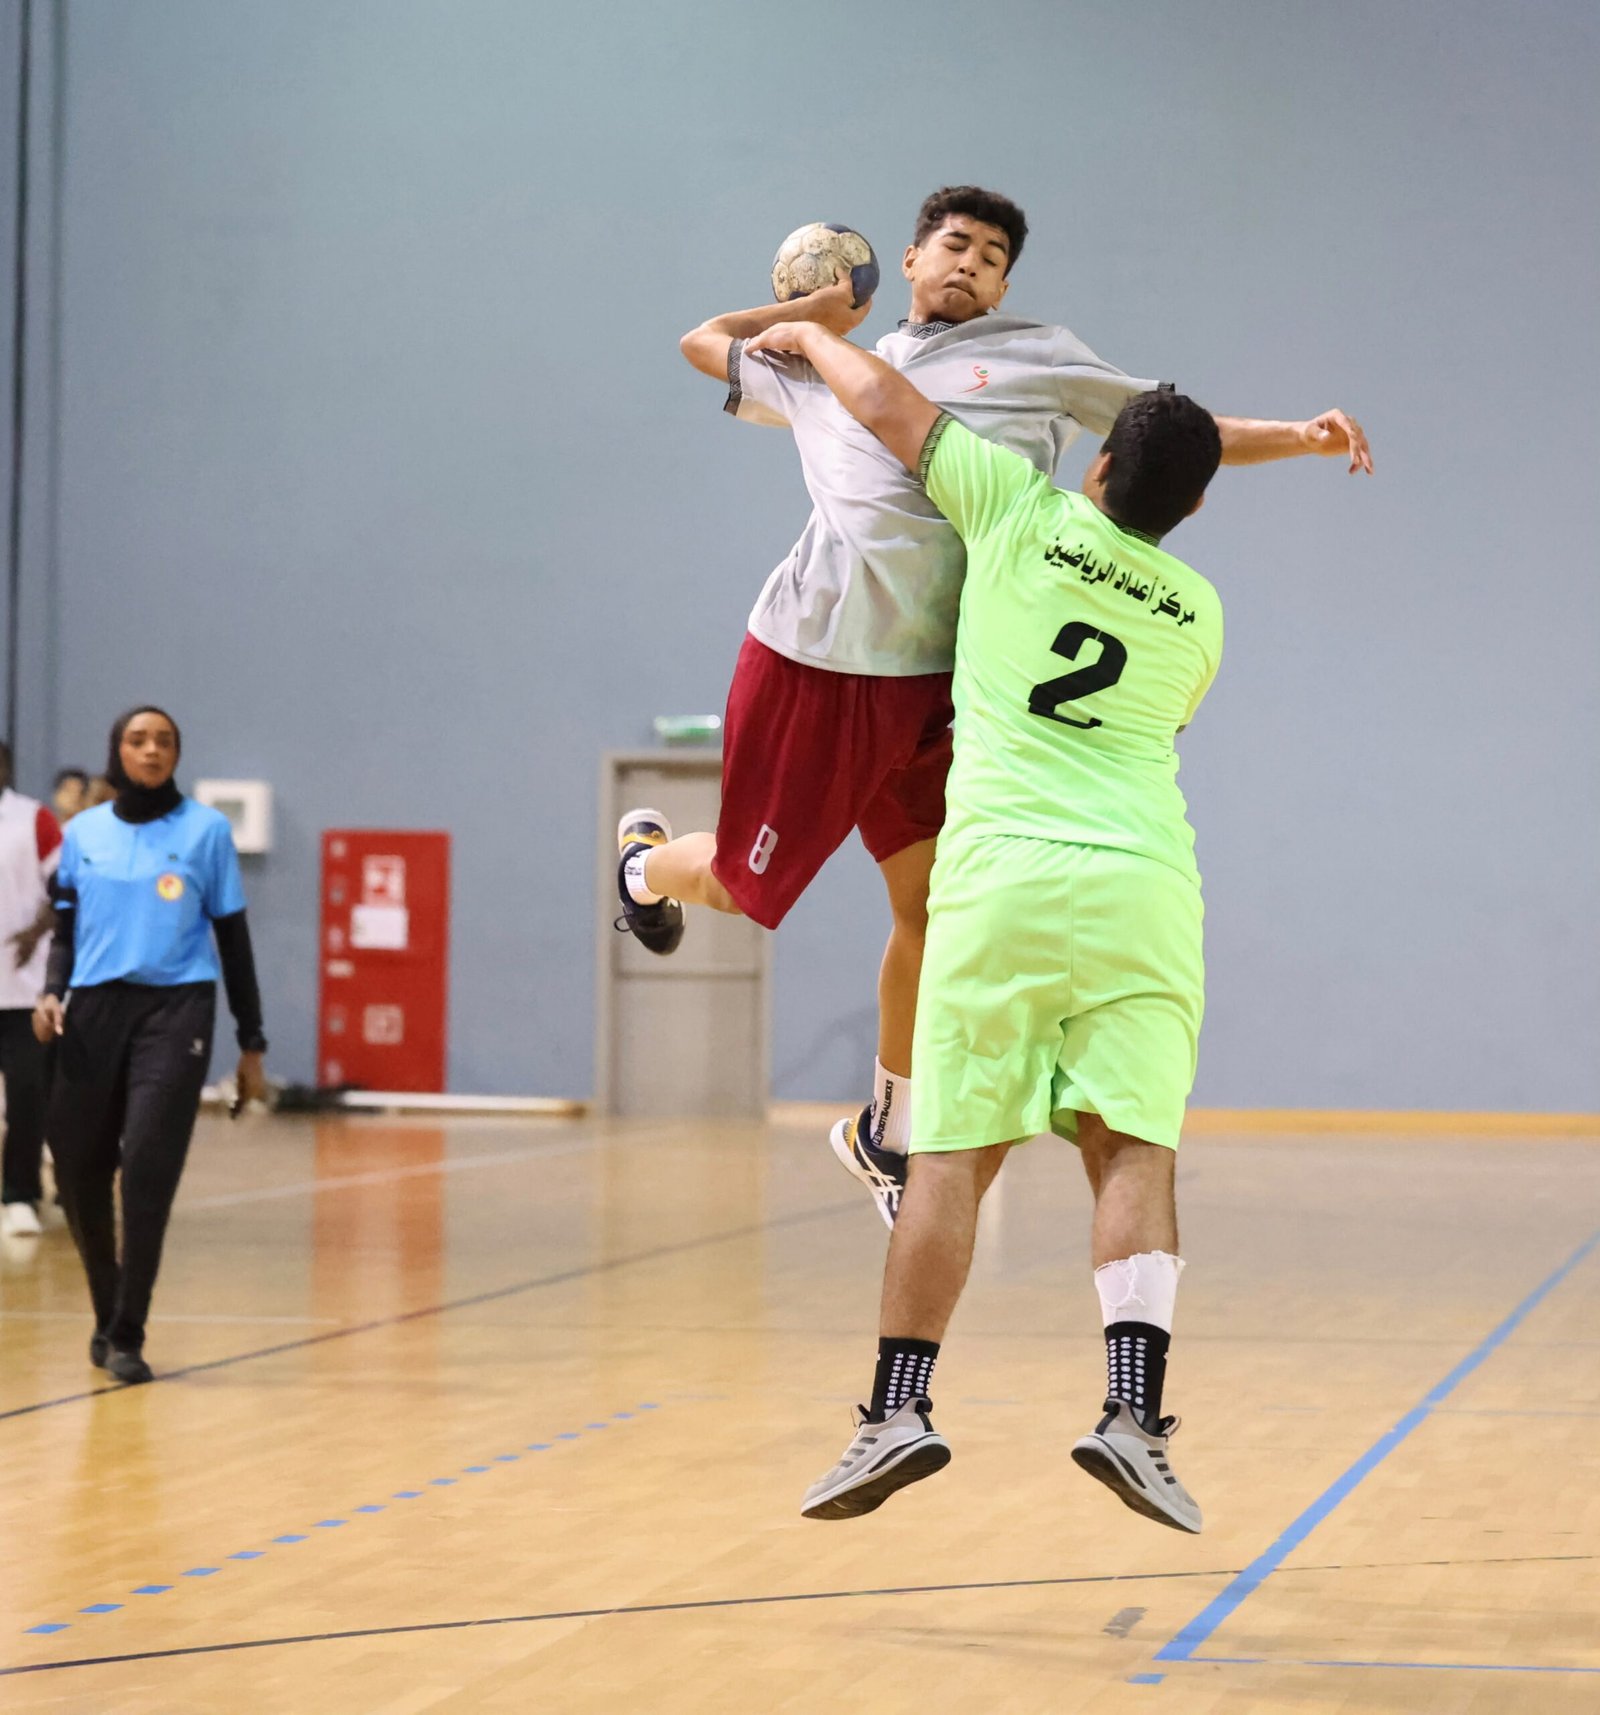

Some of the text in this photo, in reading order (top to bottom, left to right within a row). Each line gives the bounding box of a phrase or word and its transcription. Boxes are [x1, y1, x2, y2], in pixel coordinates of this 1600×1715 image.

[1043, 535, 1117, 585] الرياضيين
[1150, 584, 1196, 627] مركز
[1027, 621, 1128, 730] 2
[748, 823, 779, 876] 8
